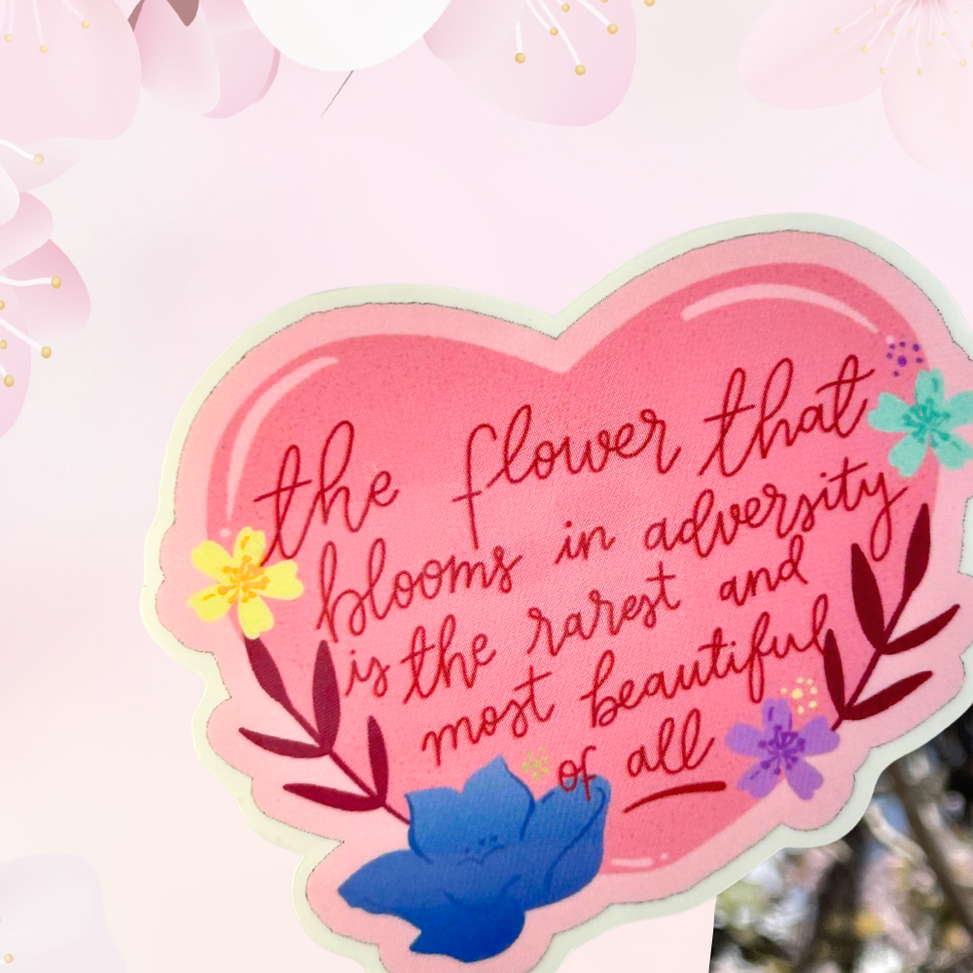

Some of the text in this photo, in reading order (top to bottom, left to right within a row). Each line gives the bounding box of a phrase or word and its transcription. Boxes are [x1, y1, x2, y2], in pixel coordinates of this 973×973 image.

[254, 354, 876, 566] the flower that
[316, 457, 908, 643] blooms in adversity
[346, 535, 809, 704] is the rarest and
[421, 594, 829, 765] most beautiful
[558, 709, 715, 801] of all
